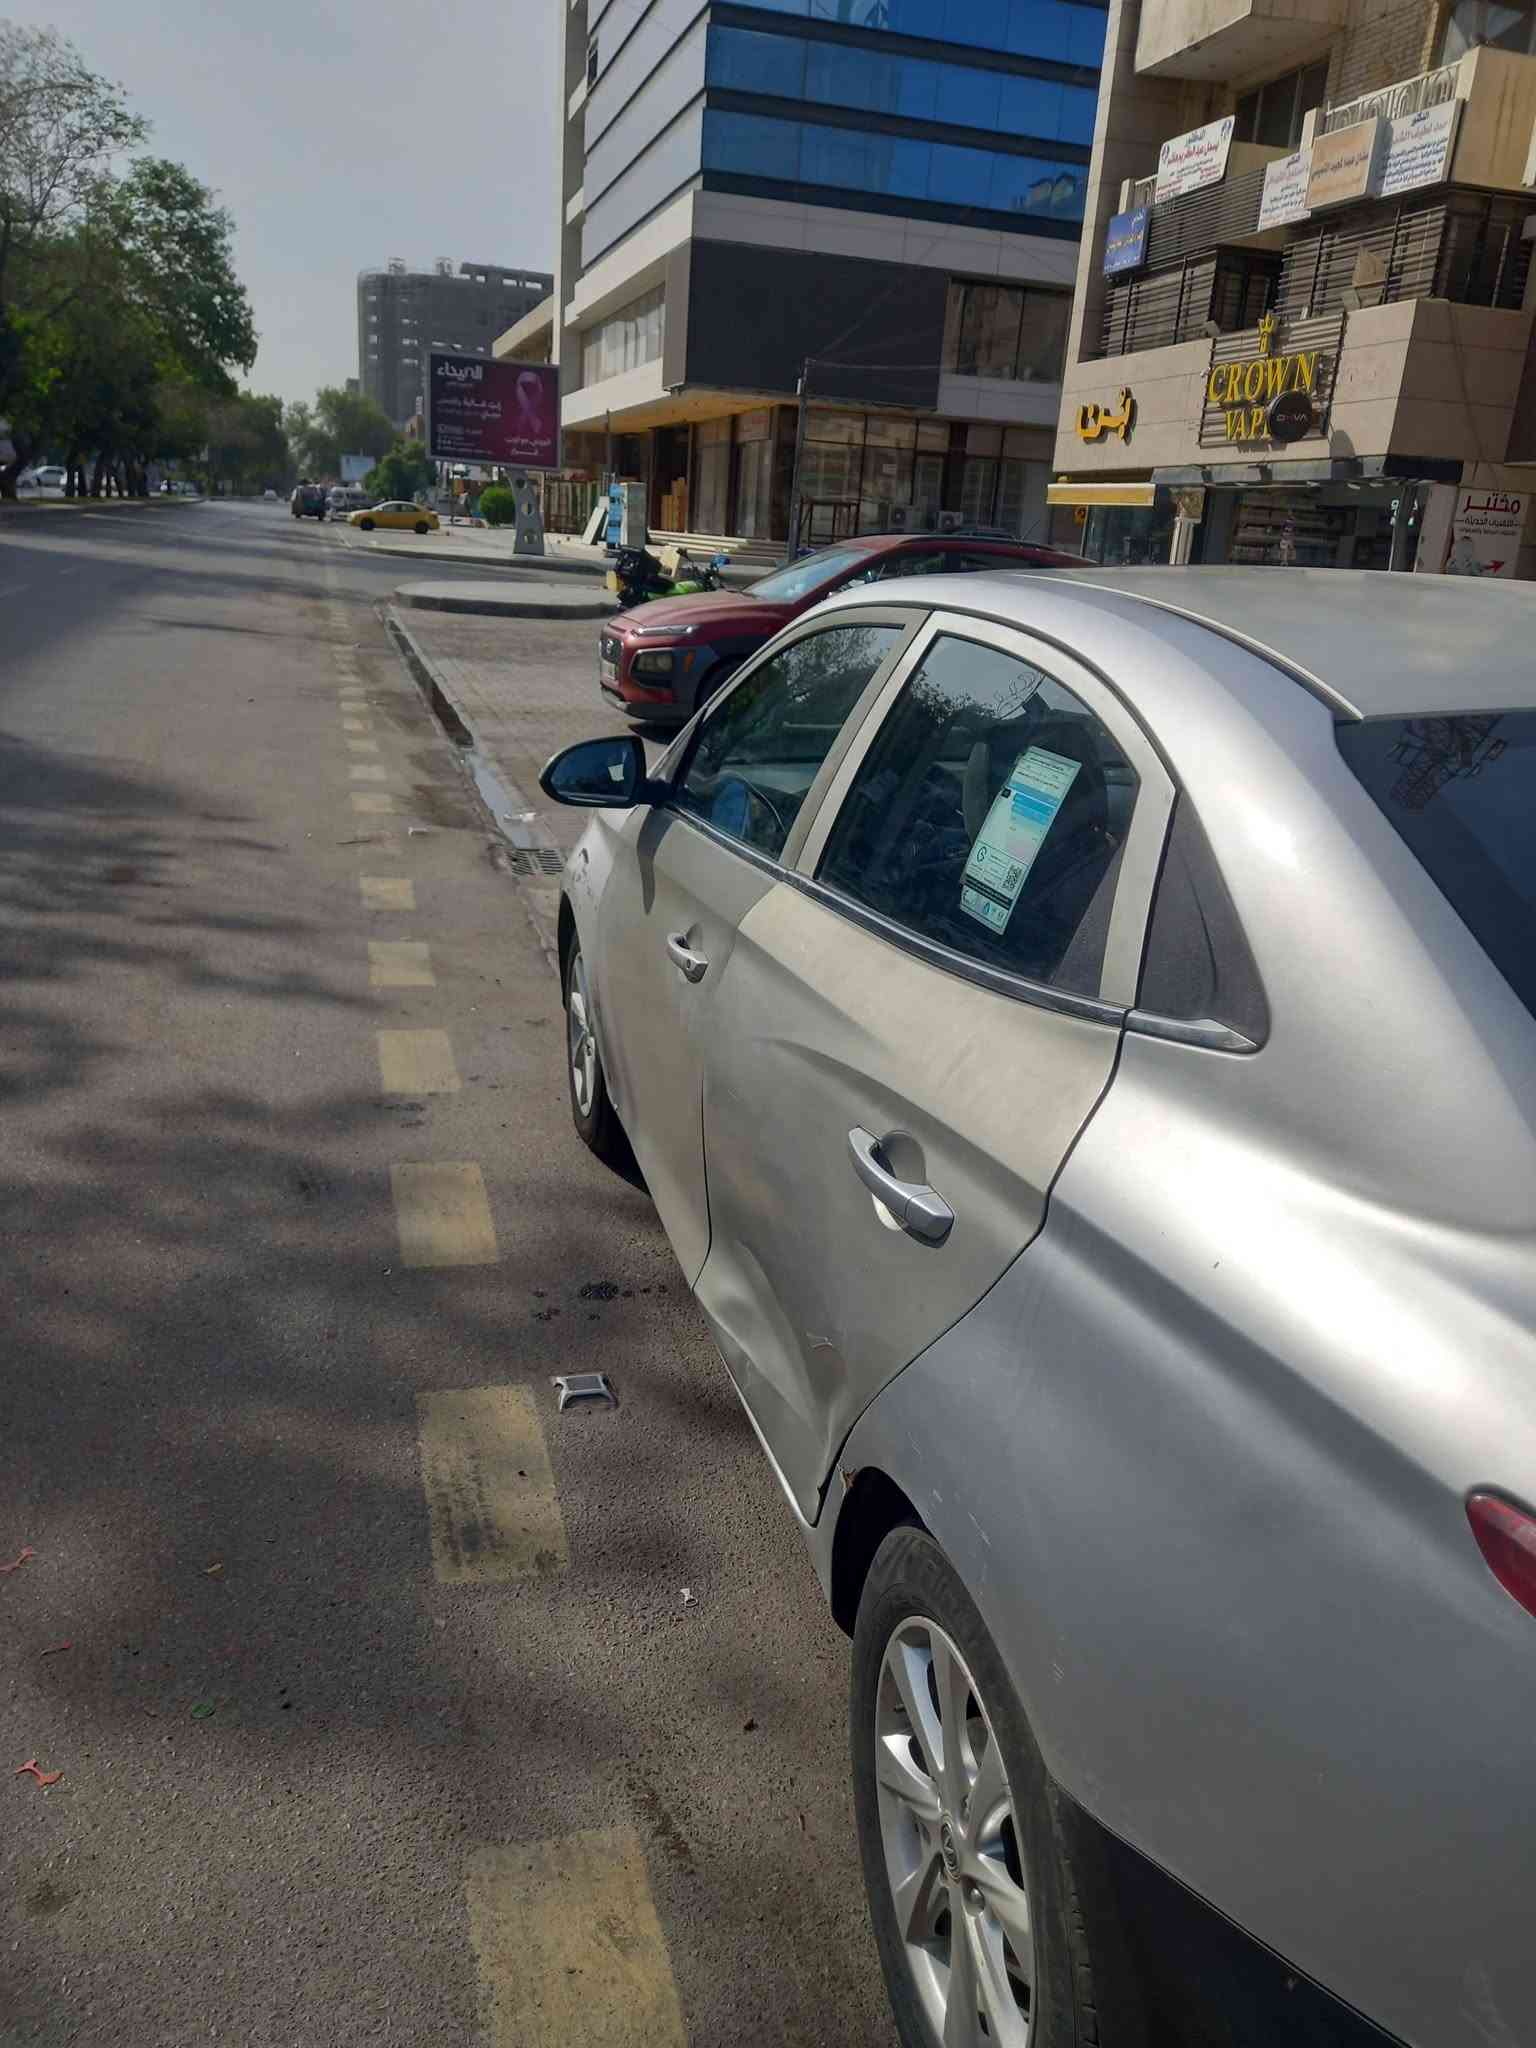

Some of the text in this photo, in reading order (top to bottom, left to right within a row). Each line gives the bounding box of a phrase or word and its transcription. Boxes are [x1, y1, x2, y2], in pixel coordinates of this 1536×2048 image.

[1208, 352, 1317, 402] CROWN
[1225, 407, 1272, 440] VAP
[1463, 493, 1521, 515] مختبر
